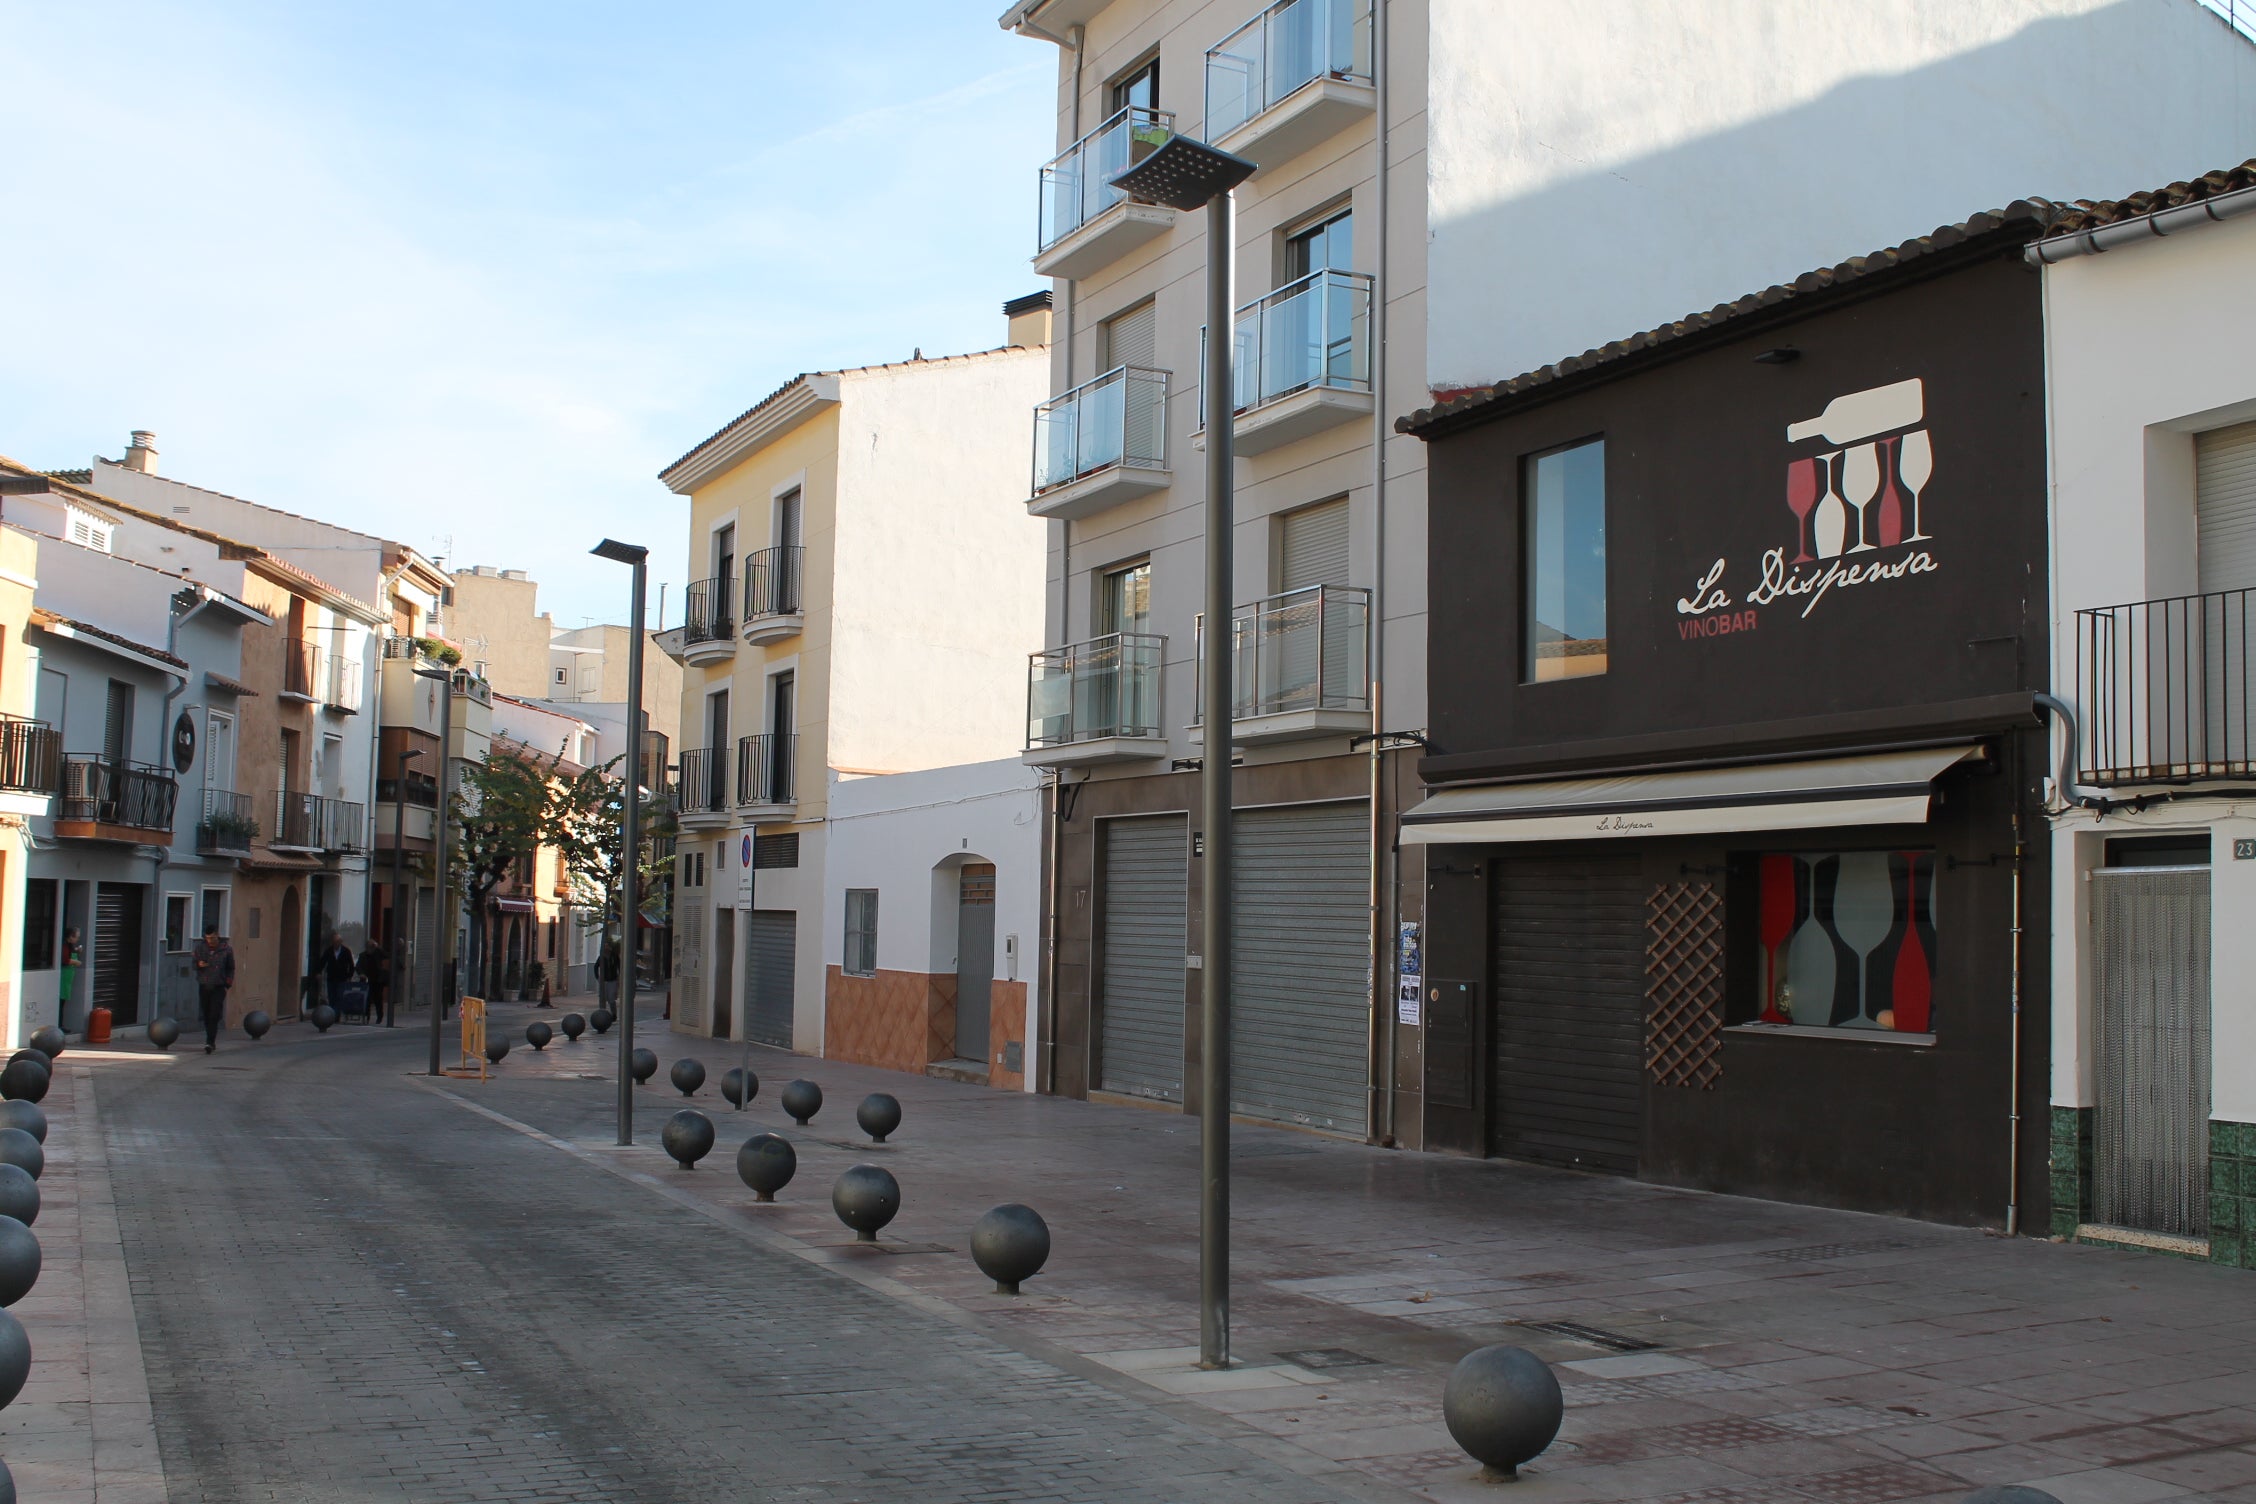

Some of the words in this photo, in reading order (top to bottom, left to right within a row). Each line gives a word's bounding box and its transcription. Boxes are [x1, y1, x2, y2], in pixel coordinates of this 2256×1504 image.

[1677, 558, 1731, 614] La
[1747, 546, 1938, 619] Dispensa
[1678, 610, 1757, 640] VINOBAR
[1596, 816, 1609, 830] La
[2237, 842, 2253, 856] 23
[1076, 890, 1086, 909] 17
